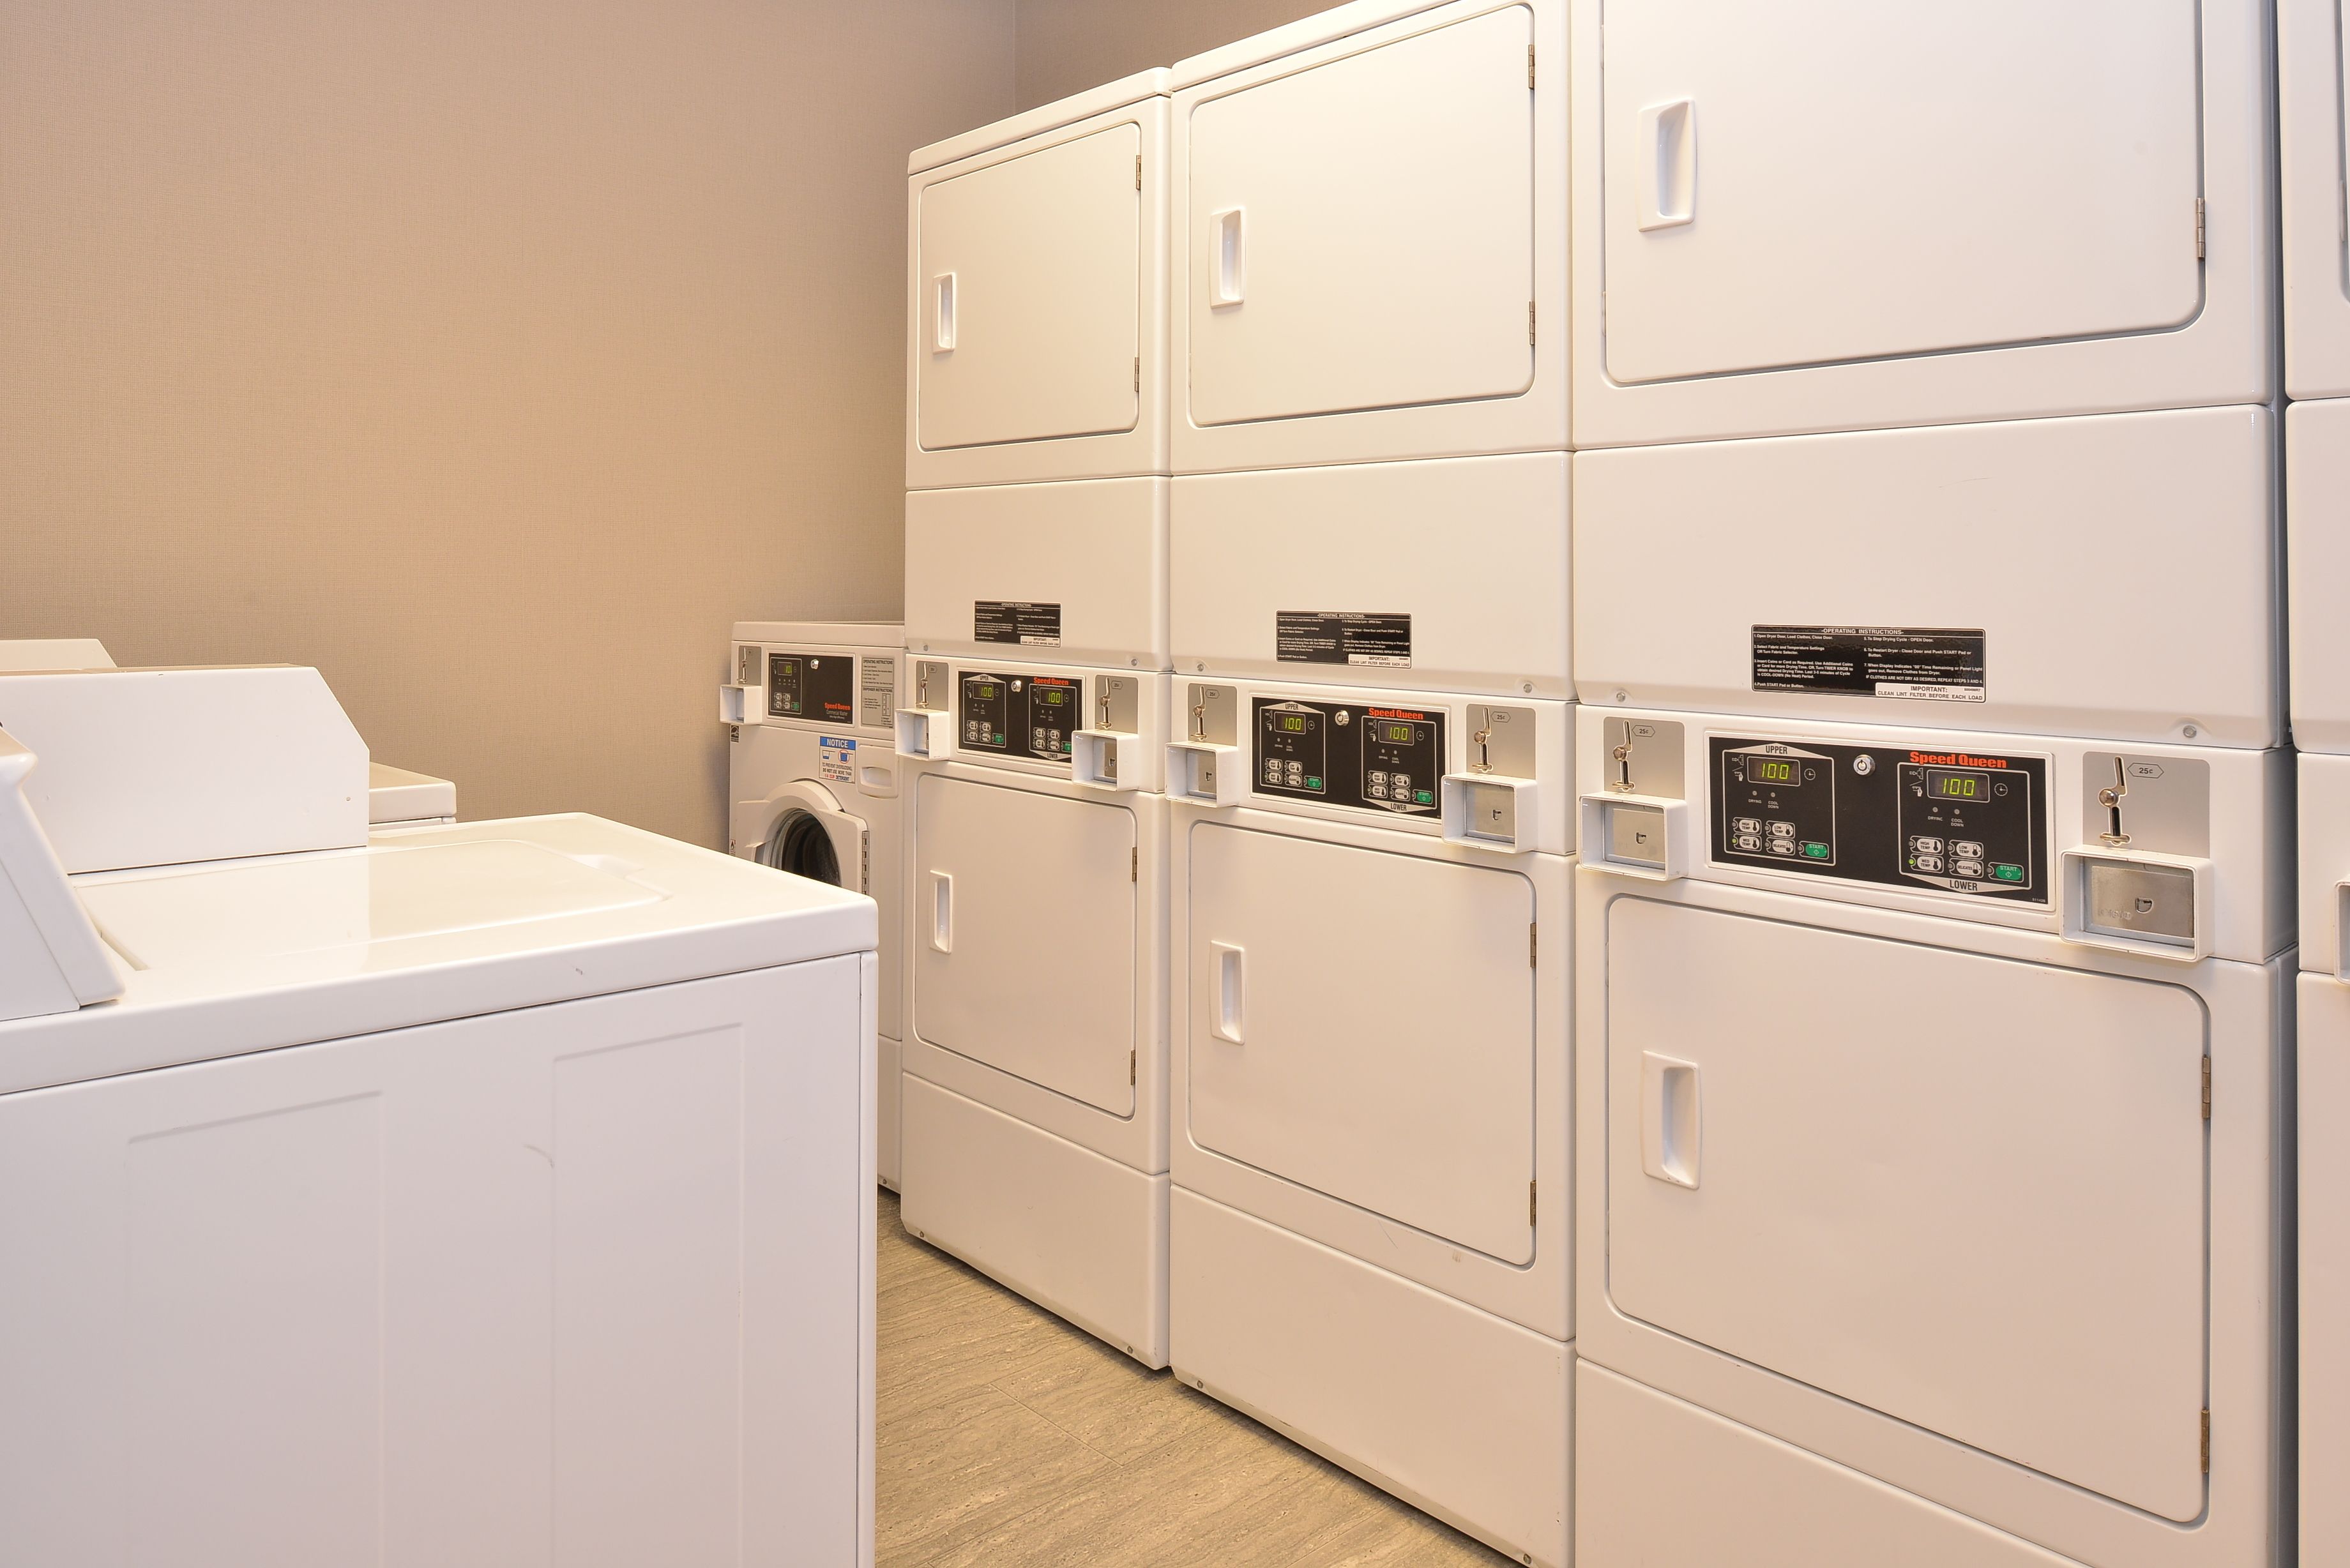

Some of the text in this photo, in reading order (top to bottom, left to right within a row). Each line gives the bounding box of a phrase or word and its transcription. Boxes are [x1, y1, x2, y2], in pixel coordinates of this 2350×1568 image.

[981, 687, 992, 697] 100
[1048, 692, 1060, 703] 100
[1368, 707, 1423, 720] Speed Queen
[1285, 718, 1301, 730] 100
[1390, 727, 1407, 740] 100
[827, 739, 848, 748] NOTICE
[1765, 746, 1787, 754] UPPER
[1910, 751, 2006, 768] Speed Queen
[1761, 763, 1789, 779] 100
[1943, 778, 1975, 796] 100
[1390, 803, 1407, 811] LOWER
[1950, 880, 1978, 891] LOWER
